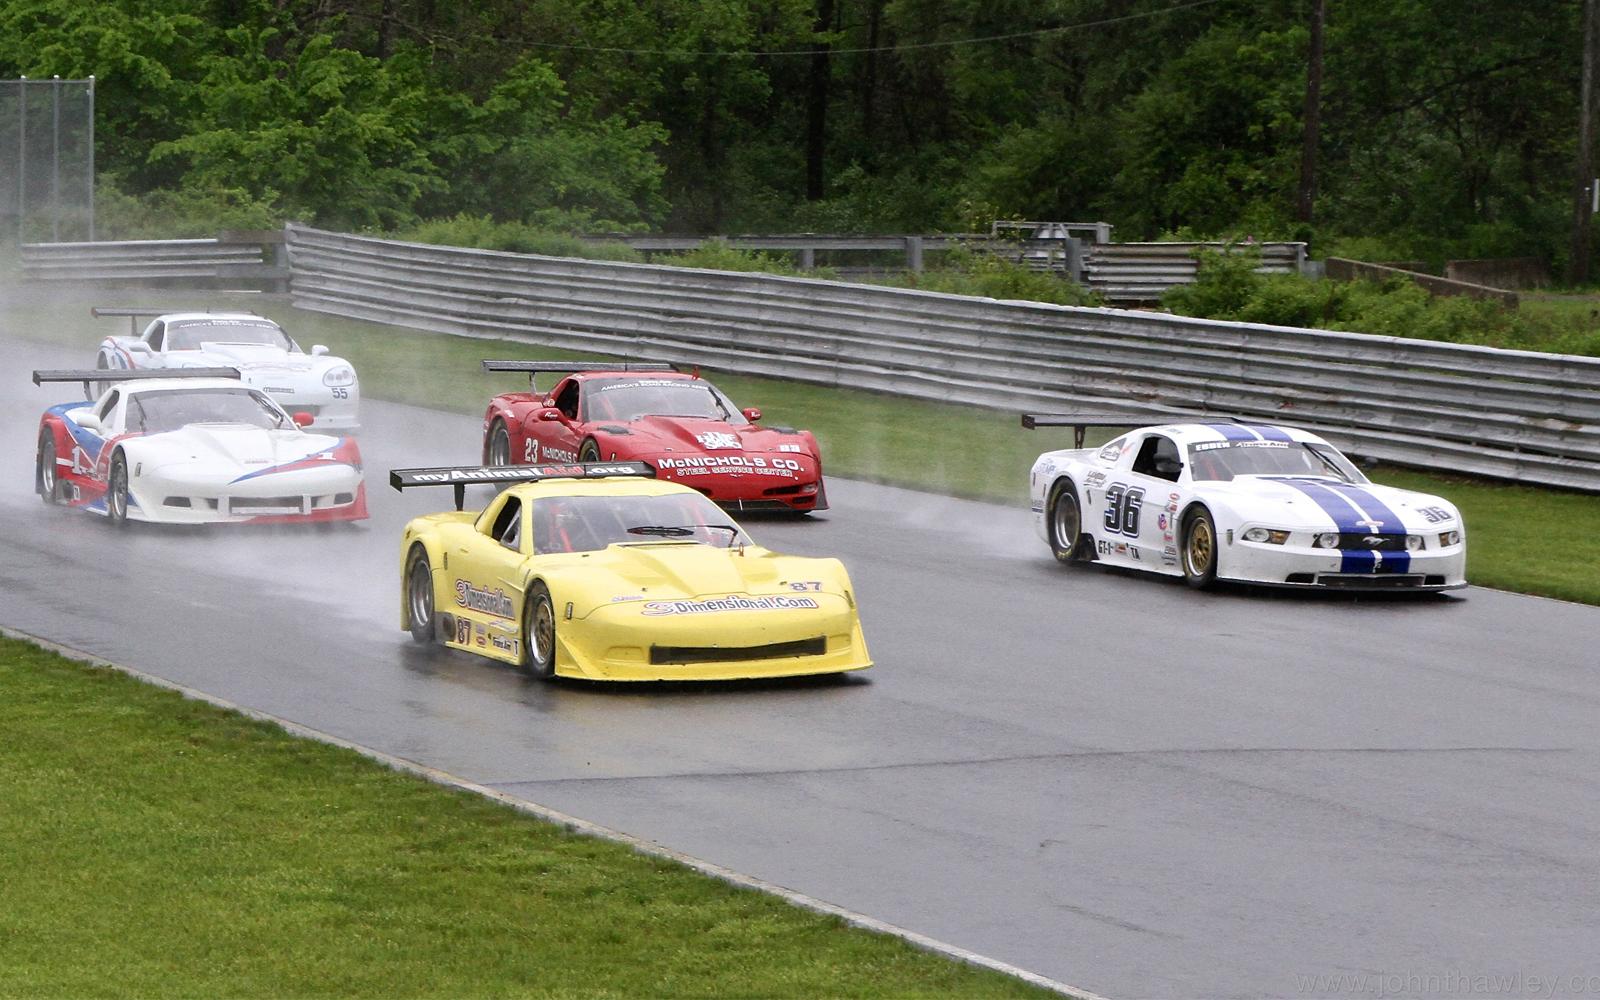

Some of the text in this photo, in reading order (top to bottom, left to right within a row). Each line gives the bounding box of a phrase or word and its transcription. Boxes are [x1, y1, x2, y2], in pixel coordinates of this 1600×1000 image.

[331, 387, 349, 400] 55
[525, 437, 539, 463] 23
[657, 456, 805, 472] McNICHOLS CO.
[676, 466, 711, 476] STEEL
[1103, 481, 1147, 539] 36
[1415, 505, 1453, 523] 36
[789, 581, 822, 592] 87
[457, 616, 471, 646] 87
